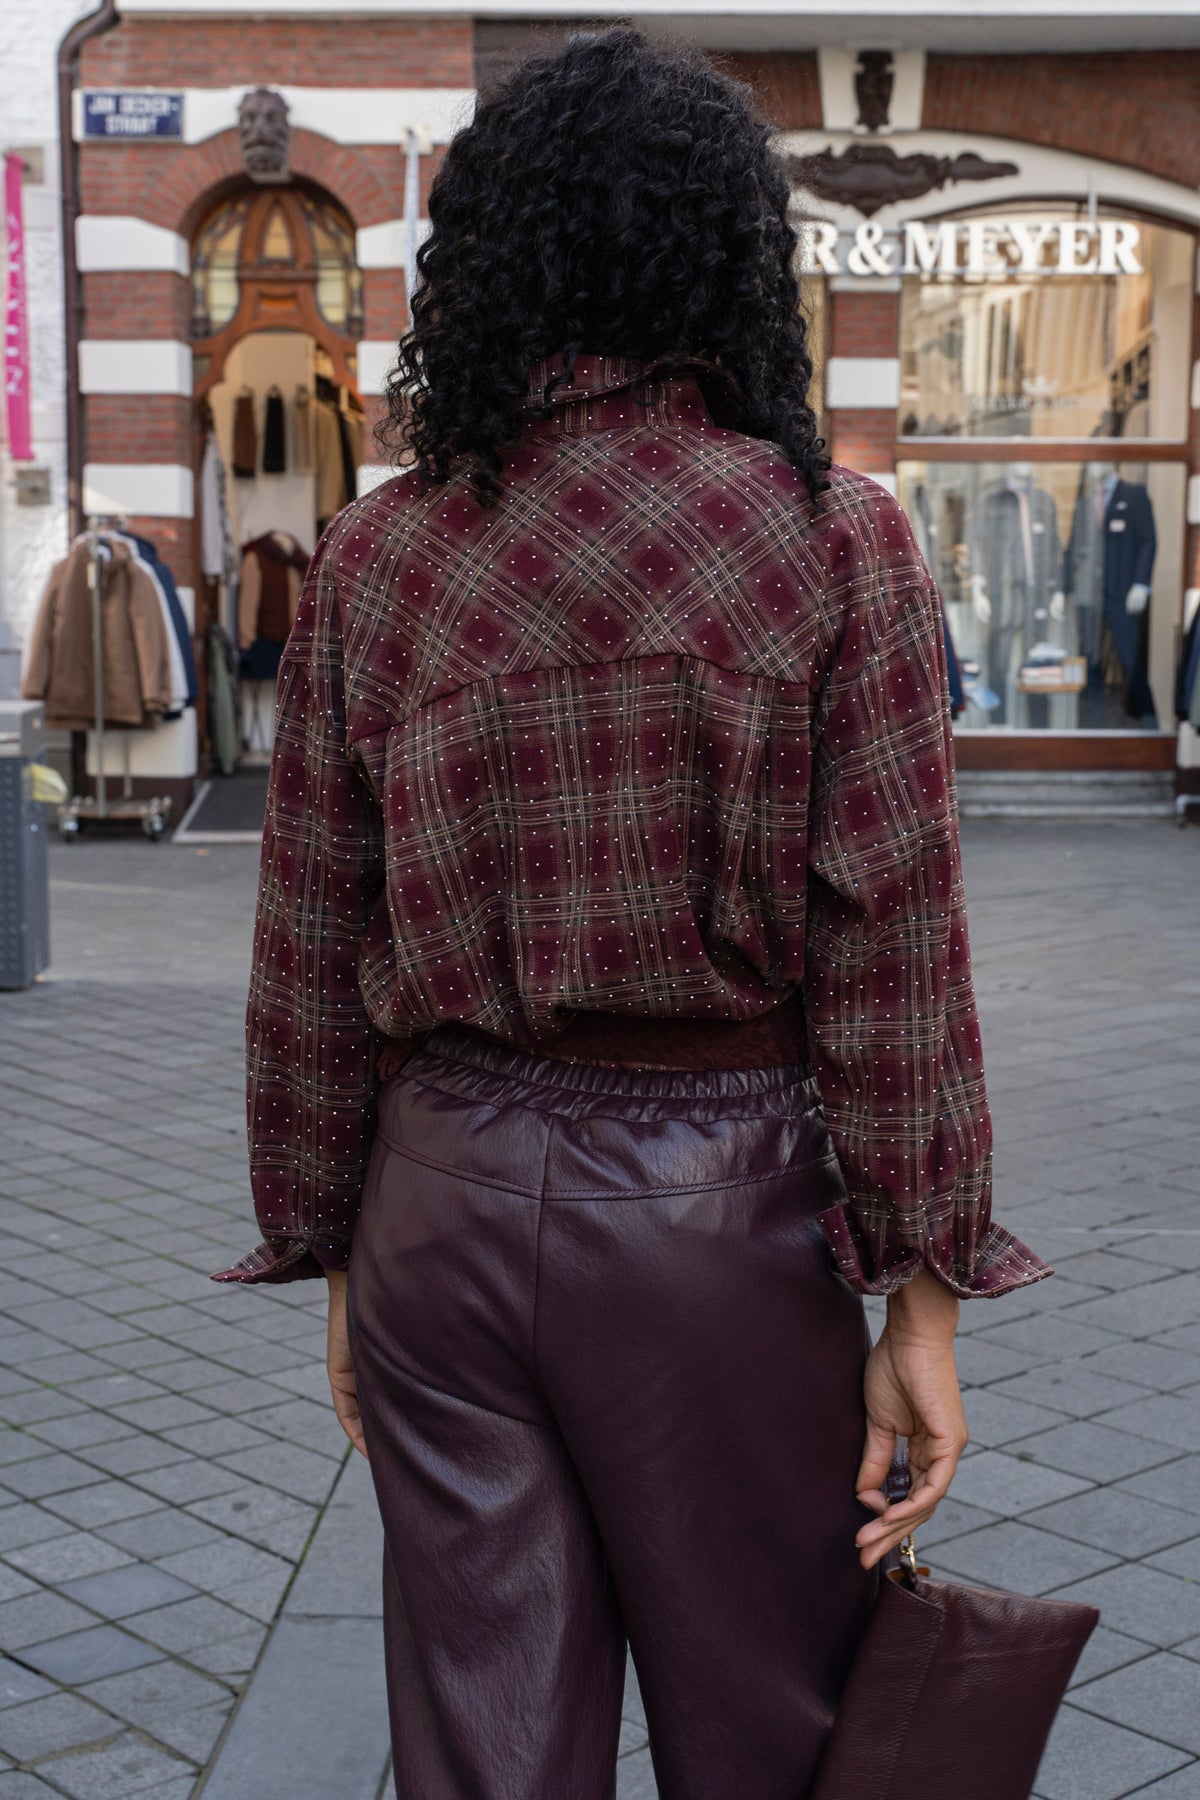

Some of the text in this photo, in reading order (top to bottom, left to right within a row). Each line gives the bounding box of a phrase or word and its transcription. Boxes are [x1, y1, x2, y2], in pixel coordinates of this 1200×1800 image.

[88, 97, 116, 114] JAN
[105, 115, 158, 134] STRAAT
[904, 221, 1145, 275] MEYER
